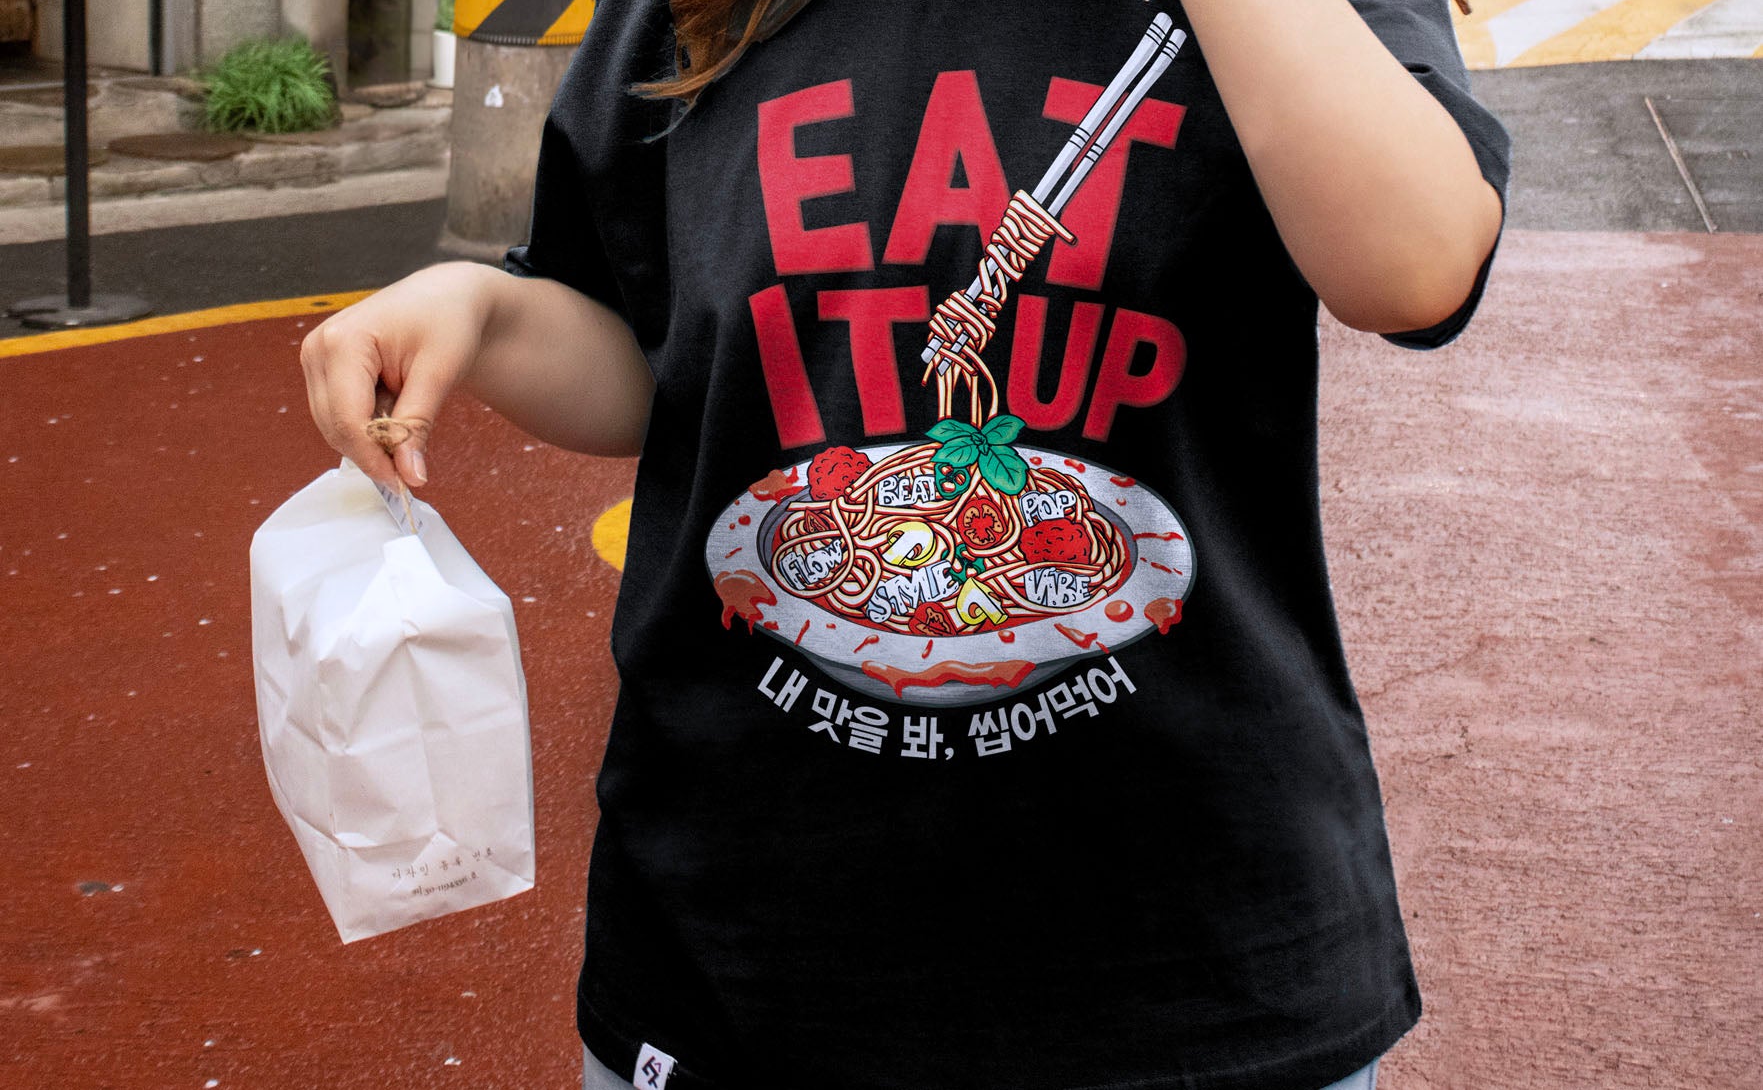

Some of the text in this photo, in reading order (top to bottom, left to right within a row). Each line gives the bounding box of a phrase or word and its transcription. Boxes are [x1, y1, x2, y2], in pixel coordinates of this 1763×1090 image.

[757, 70, 1188, 291] EAT
[748, 283, 1188, 450] IT UP
[878, 474, 938, 507] BEAT
[1020, 490, 1077, 528] POP
[779, 539, 843, 591] FLOW
[866, 560, 960, 624] STYLE
[1024, 567, 1092, 608] VIBE
[757, 656, 1137, 762] 내 맛을 봐, 씹어먹어
